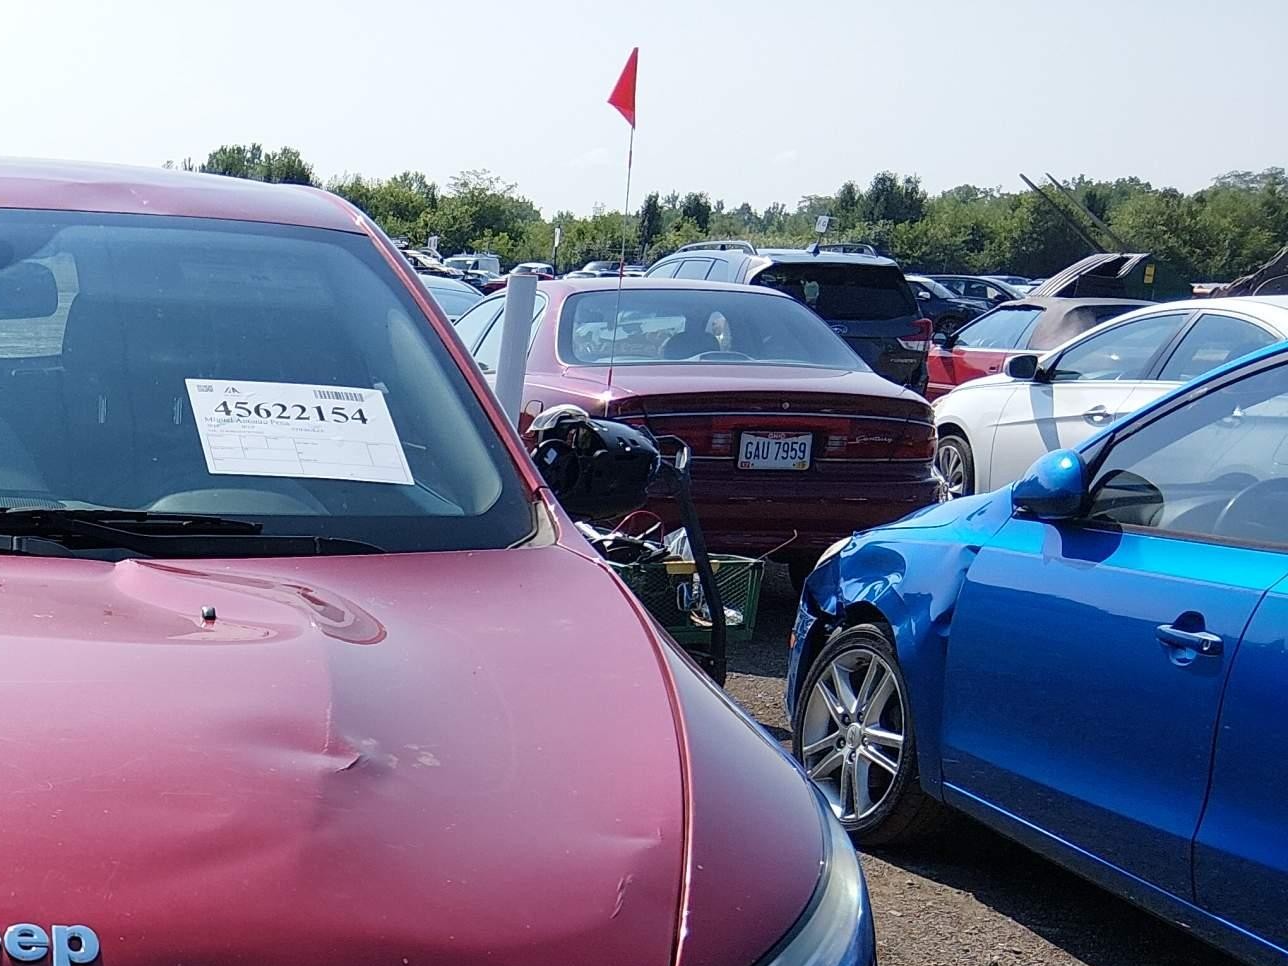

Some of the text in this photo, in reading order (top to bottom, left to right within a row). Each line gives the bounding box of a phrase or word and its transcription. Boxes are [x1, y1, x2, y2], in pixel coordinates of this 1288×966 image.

[213, 400, 369, 425] 45622154
[744, 441, 807, 461] GAU 7959
